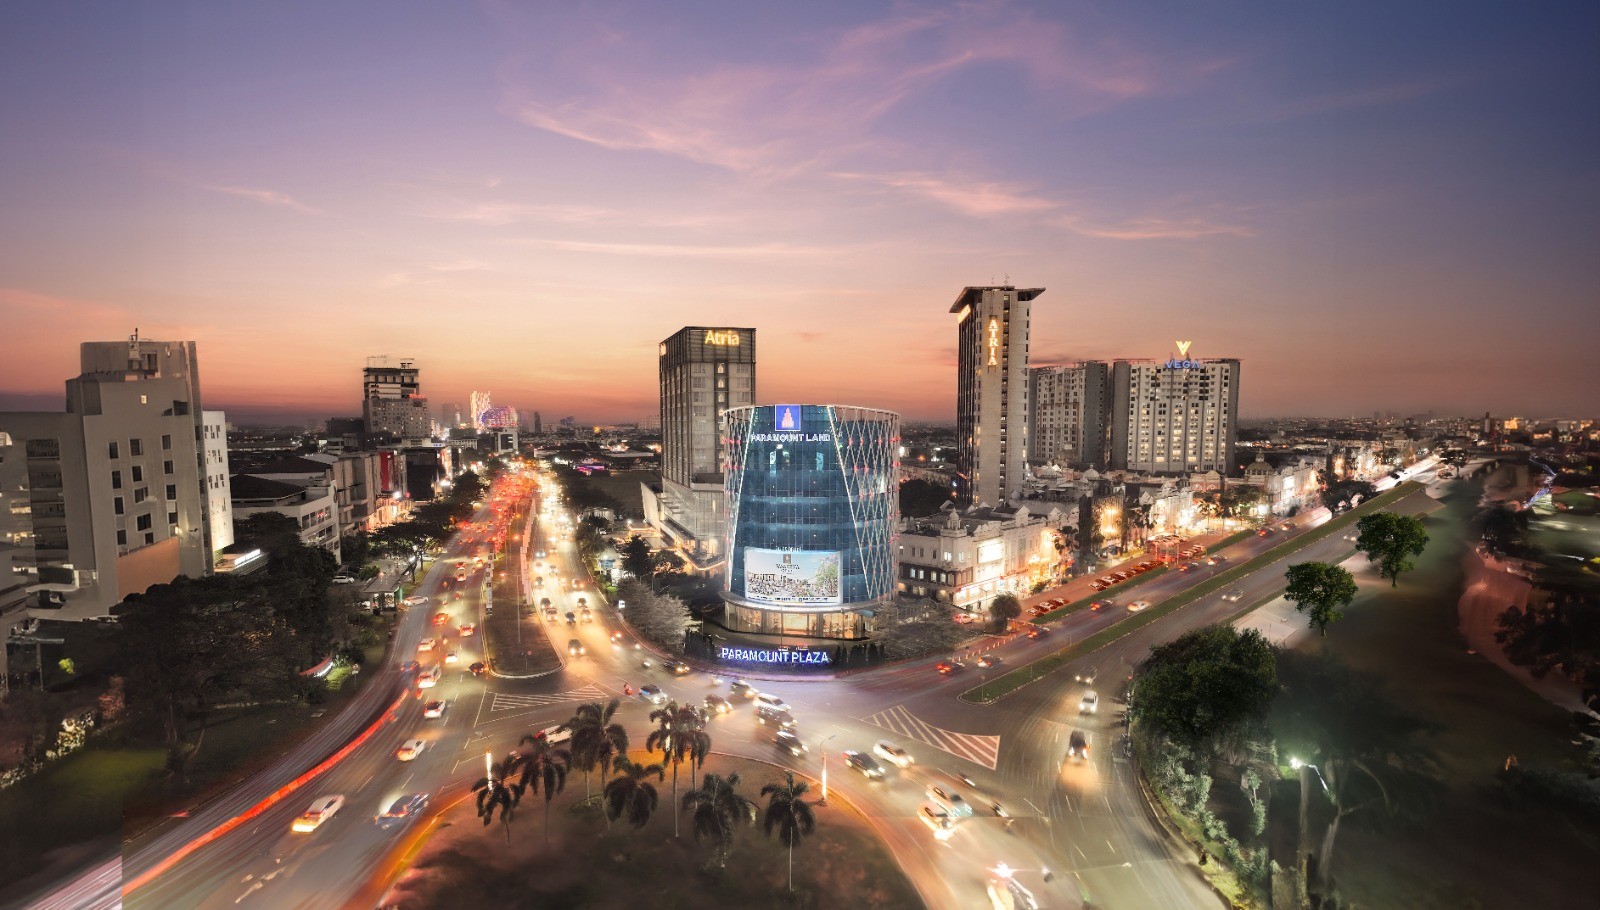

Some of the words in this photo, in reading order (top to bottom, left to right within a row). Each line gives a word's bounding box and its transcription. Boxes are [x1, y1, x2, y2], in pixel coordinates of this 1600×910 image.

[704, 330, 740, 345] Atria
[988, 319, 999, 366] ATRIA
[1165, 360, 1200, 369] VEGA
[751, 433, 804, 442] PARAMOUNT
[806, 433, 831, 442] LAND
[721, 647, 789, 662] PARAMOUNT
[791, 651, 829, 663] PLAZA
